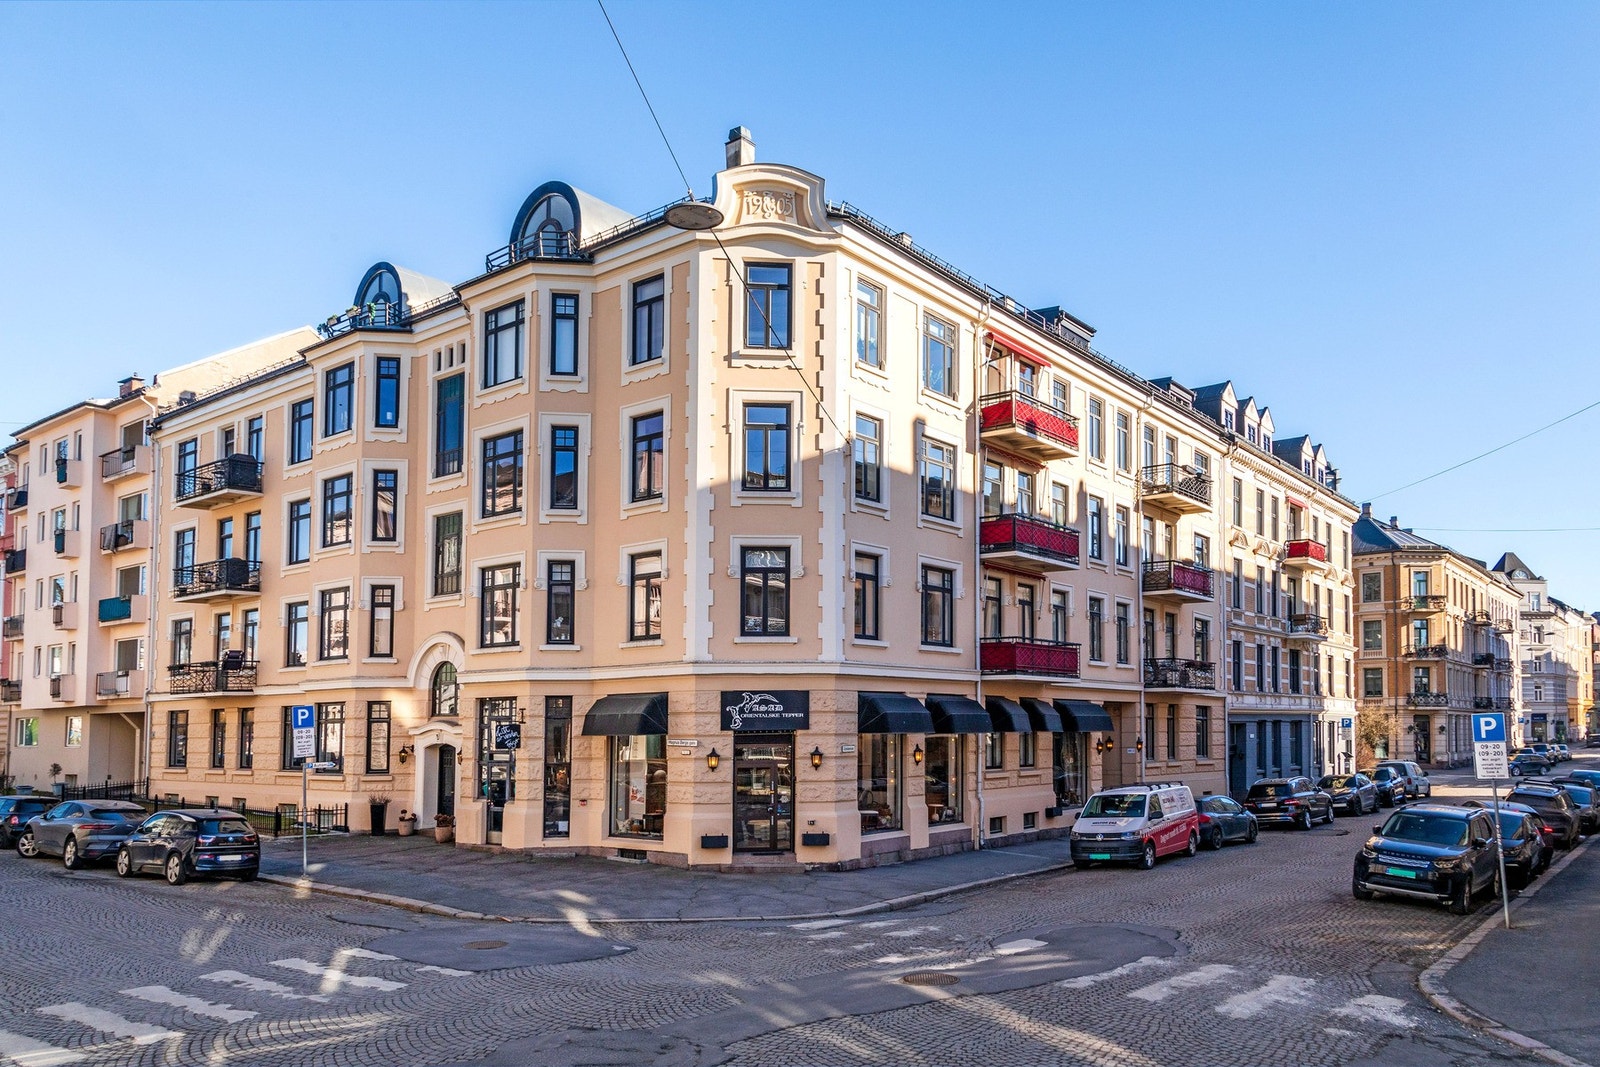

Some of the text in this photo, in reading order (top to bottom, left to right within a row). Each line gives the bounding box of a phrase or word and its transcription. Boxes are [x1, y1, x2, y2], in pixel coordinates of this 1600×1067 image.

[752, 704, 784, 712] ASAD
[298, 709, 309, 726] P
[1480, 717, 1497, 738] P
